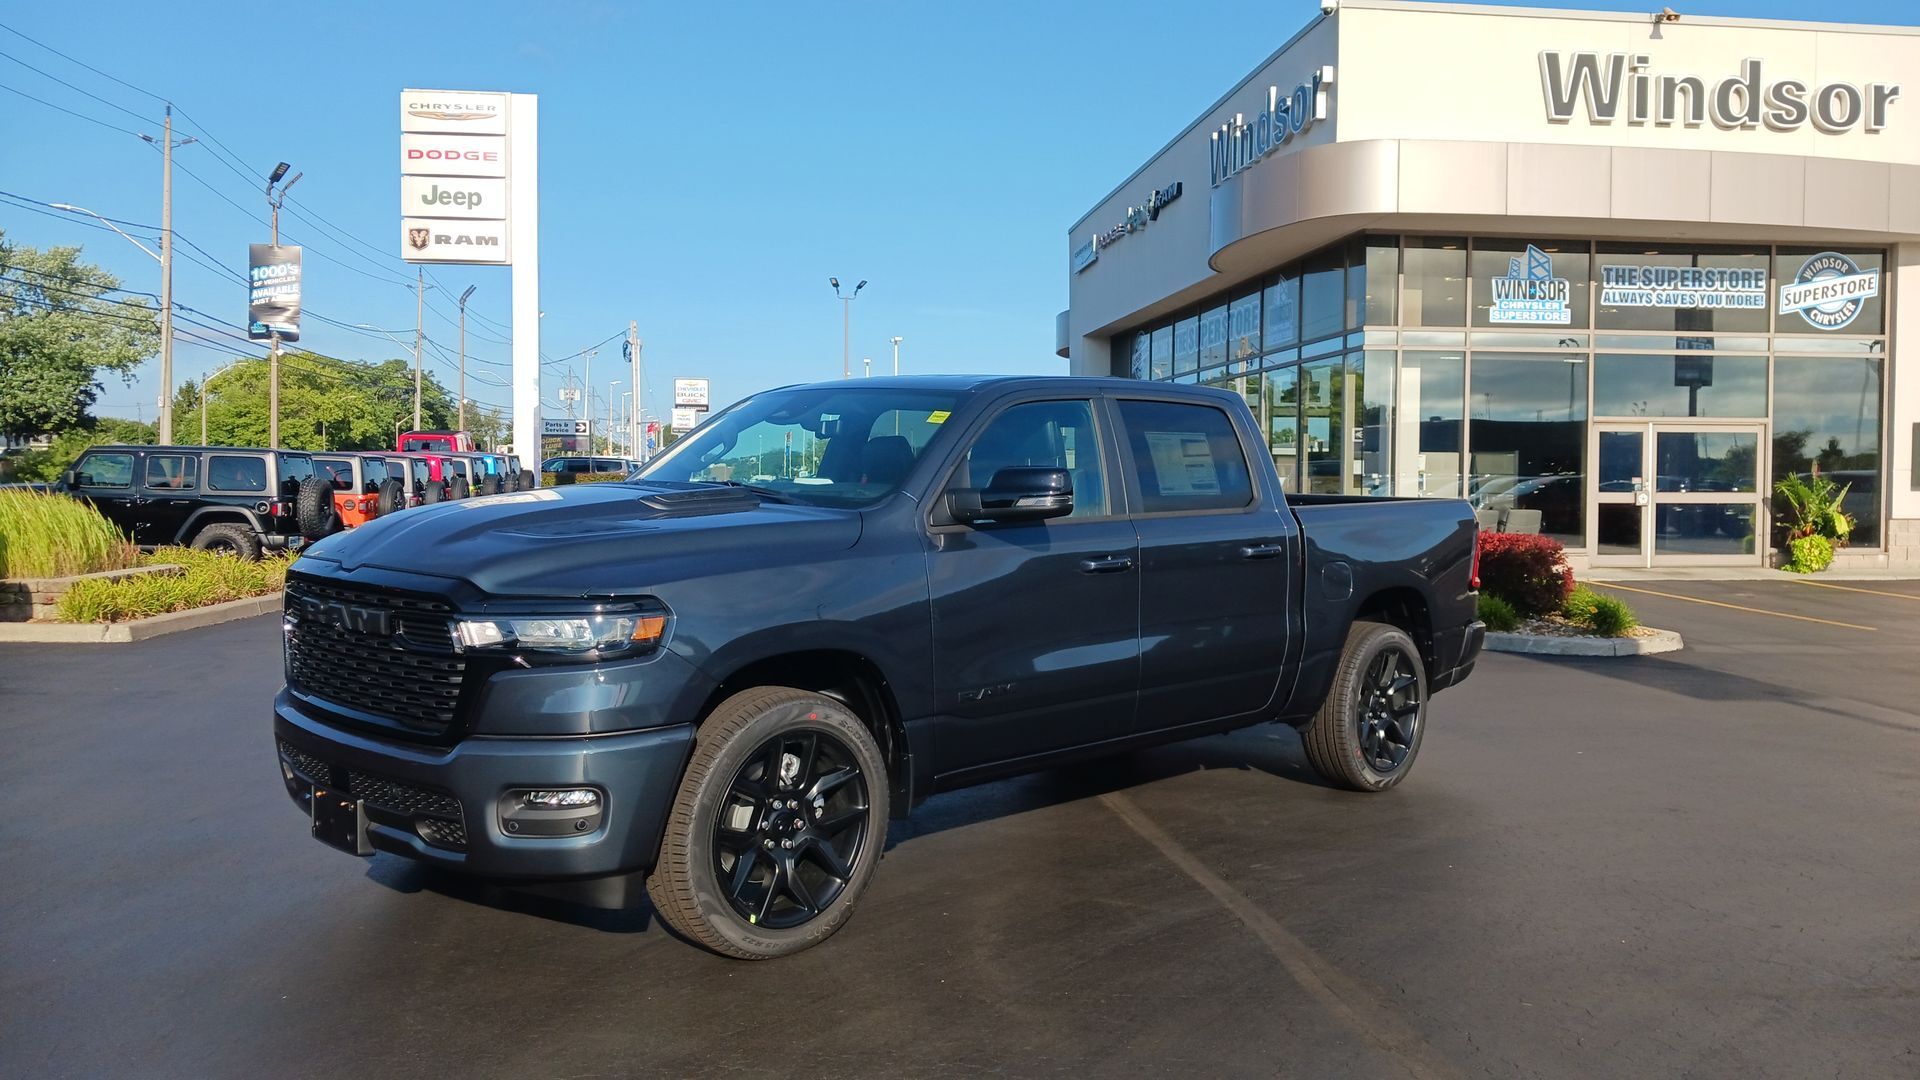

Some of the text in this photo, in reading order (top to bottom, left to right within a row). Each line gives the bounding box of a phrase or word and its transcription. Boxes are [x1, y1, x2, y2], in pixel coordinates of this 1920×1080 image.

[1539, 50, 1900, 132] Windsor
[408, 102, 497, 112] CHRYSLER
[1208, 65, 1334, 188] Windsor
[407, 149, 498, 161] DODGE
[421, 184, 483, 210] Jeep
[434, 234, 499, 246] RAM
[1603, 266, 1765, 289] THE SUPERSTORE
[1803, 257, 1849, 279] WINDSOR
[251, 284, 299, 299] AVAILABLE
[264, 276, 296, 285] VEHICLES
[1494, 279, 1567, 301] WINDSOR
[1784, 276, 1875, 307] SUPERSTORE
[1500, 301, 1560, 310] CHRYSLER
[1603, 291, 1765, 307] ALWAYS SAVES YOU MORE!
[1493, 310, 1568, 321] SUPERSTORE
[1810, 301, 1857, 325] CHRYSLER
[300, 596, 390, 636] RAM
